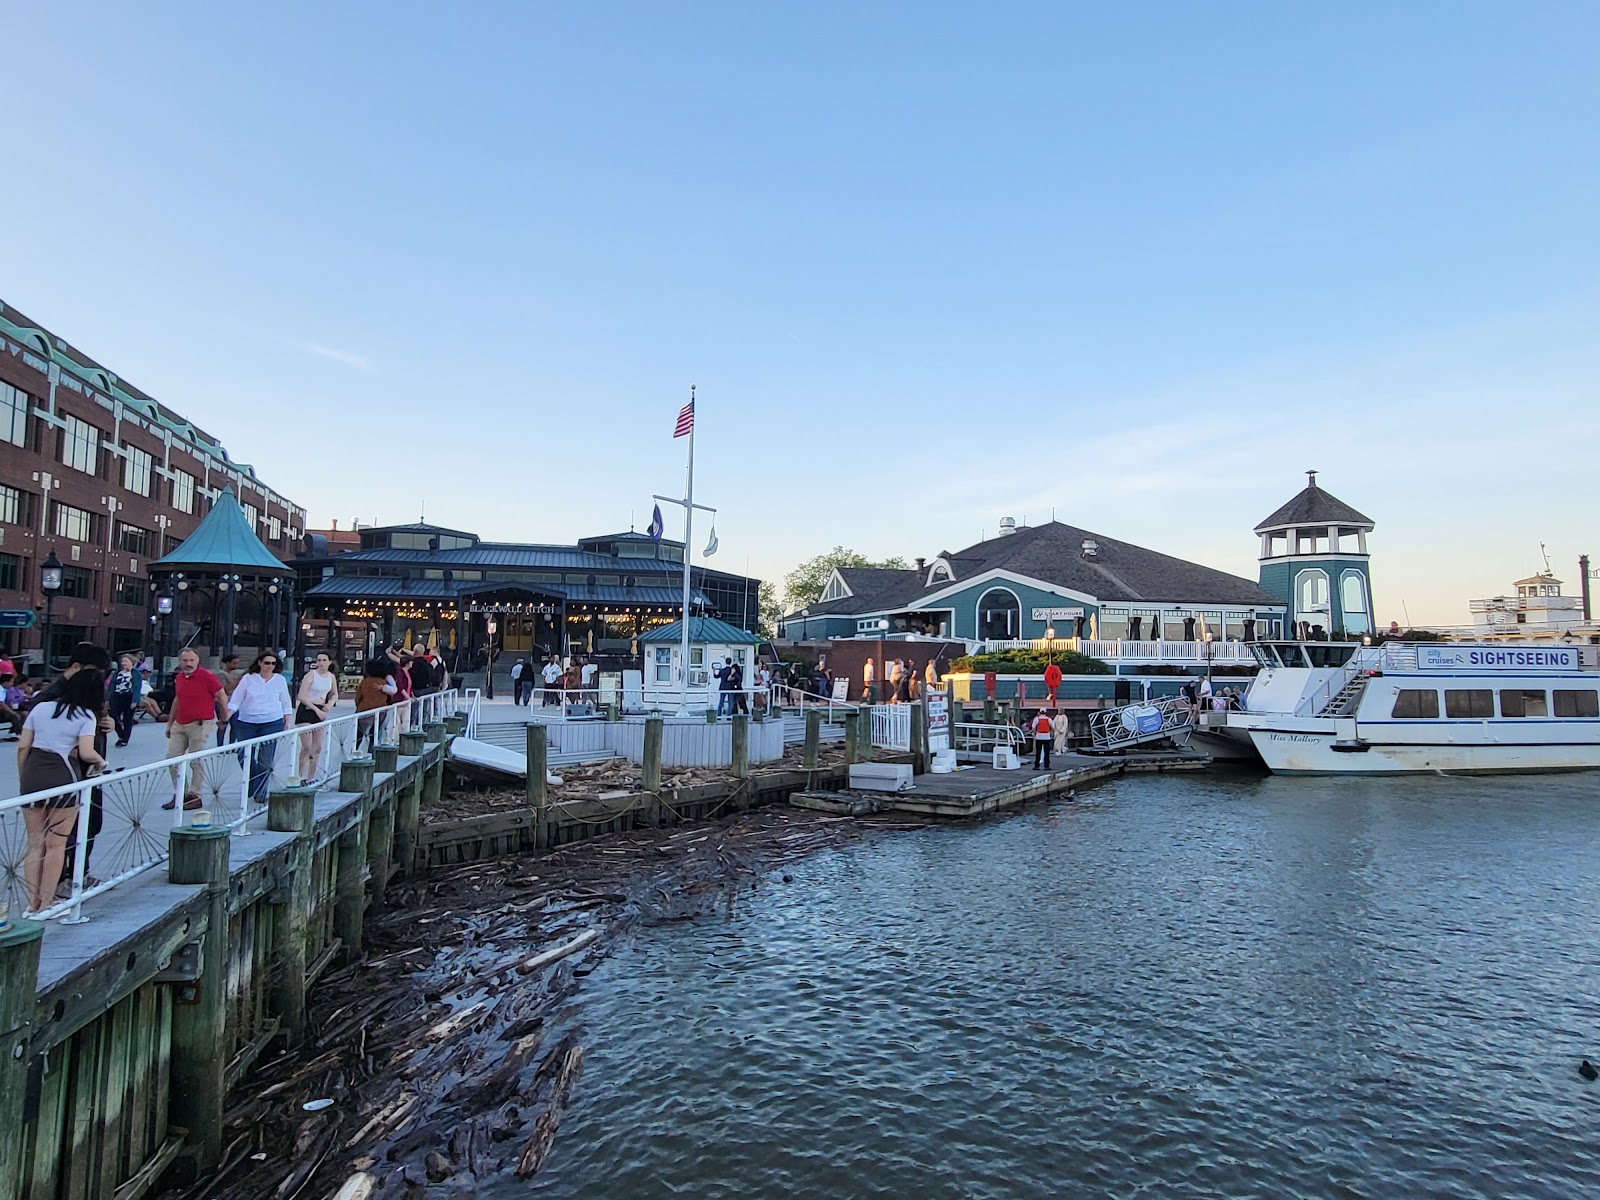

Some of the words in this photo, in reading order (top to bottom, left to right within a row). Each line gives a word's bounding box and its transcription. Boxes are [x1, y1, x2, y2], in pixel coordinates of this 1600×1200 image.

[469, 605, 522, 613] BLACKWALL
[525, 605, 555, 614] HITCH
[1427, 650, 1441, 658] city
[1470, 651, 1570, 666] SIGHTSEEING
[1427, 656, 1455, 665] cruises
[1289, 735, 1322, 745] Mallory
